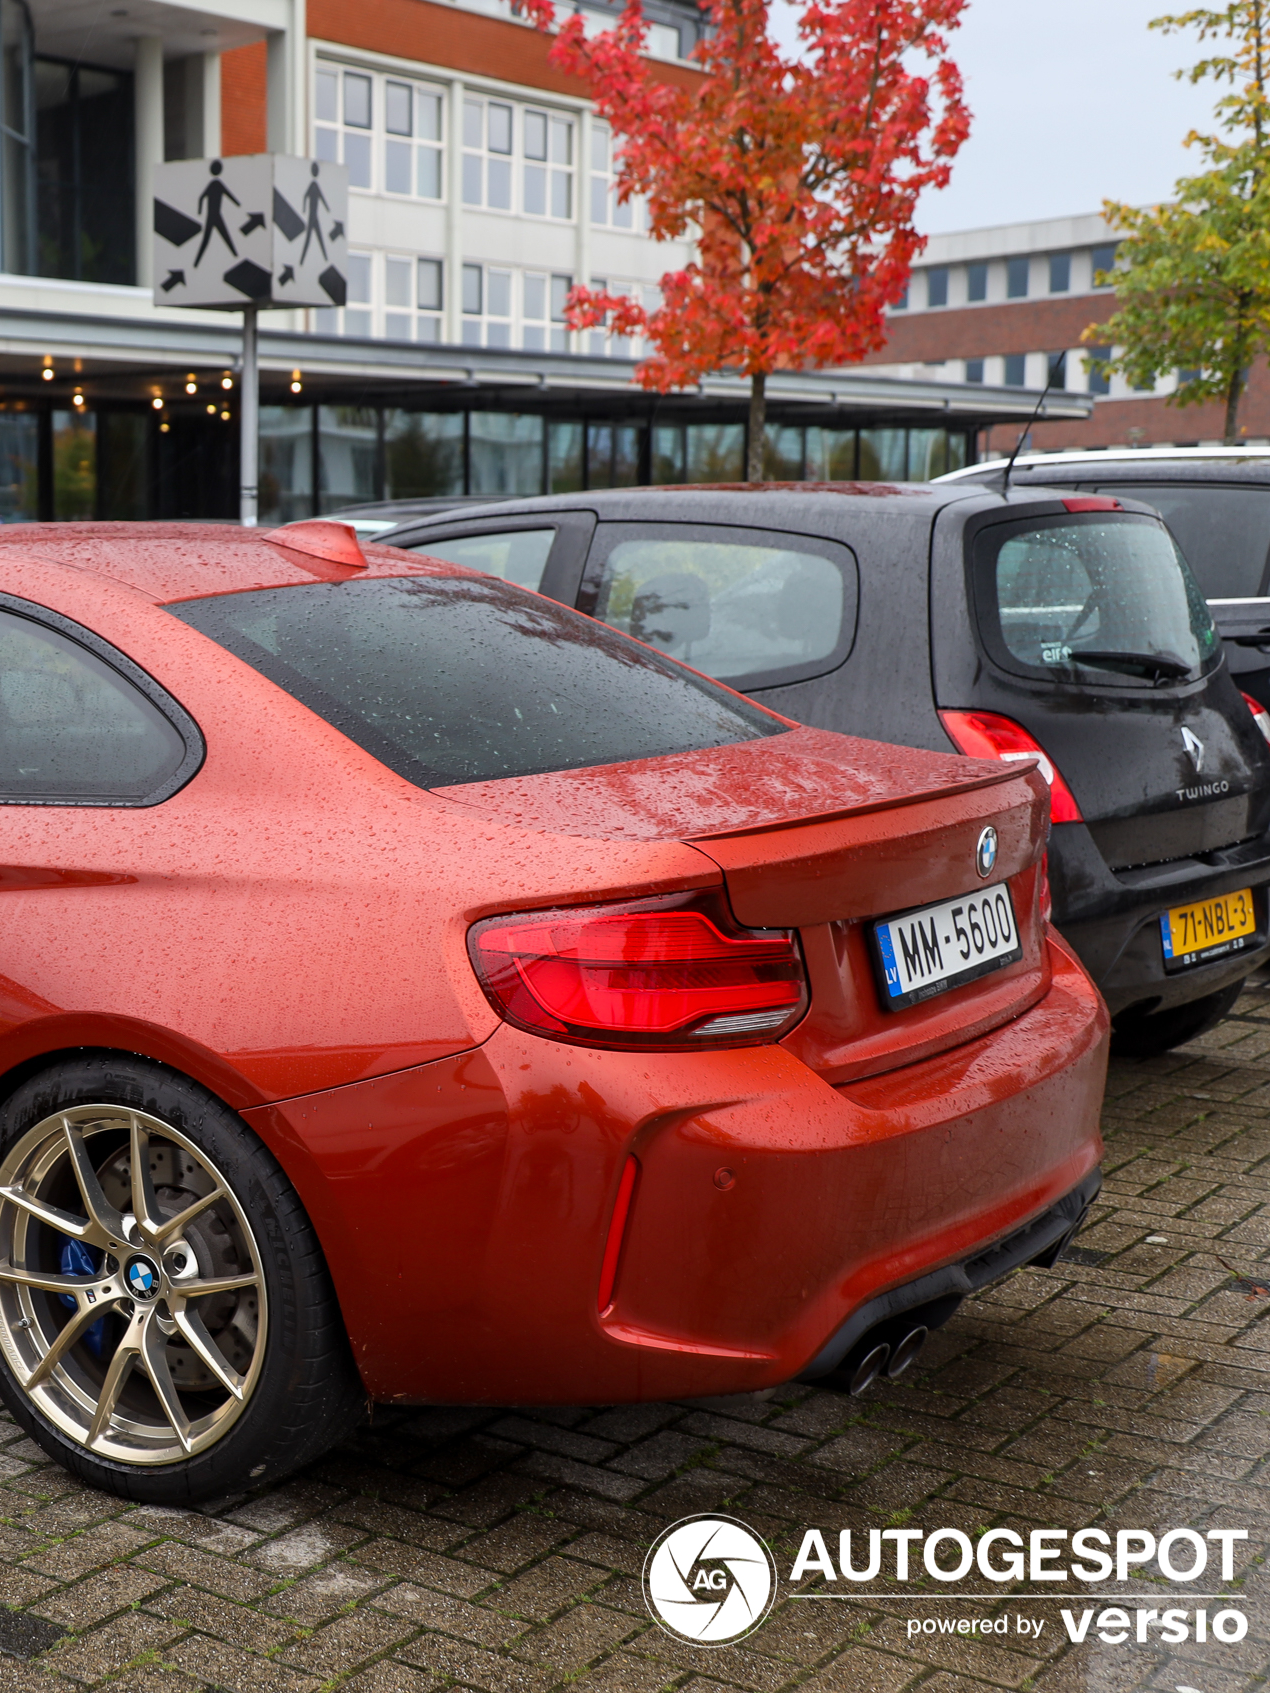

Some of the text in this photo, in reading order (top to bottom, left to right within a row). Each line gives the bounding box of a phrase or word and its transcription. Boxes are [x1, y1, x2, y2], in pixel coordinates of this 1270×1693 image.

[1042, 648, 1061, 661] elf
[1176, 780, 1229, 801] TWINGO
[1179, 895, 1247, 946] 71-NBL-3
[898, 893, 1011, 982] MM-5600
[885, 966, 897, 985] LV
[132, 1280, 159, 1298] BMW
[265, 1217, 296, 1353] MICHELIN
